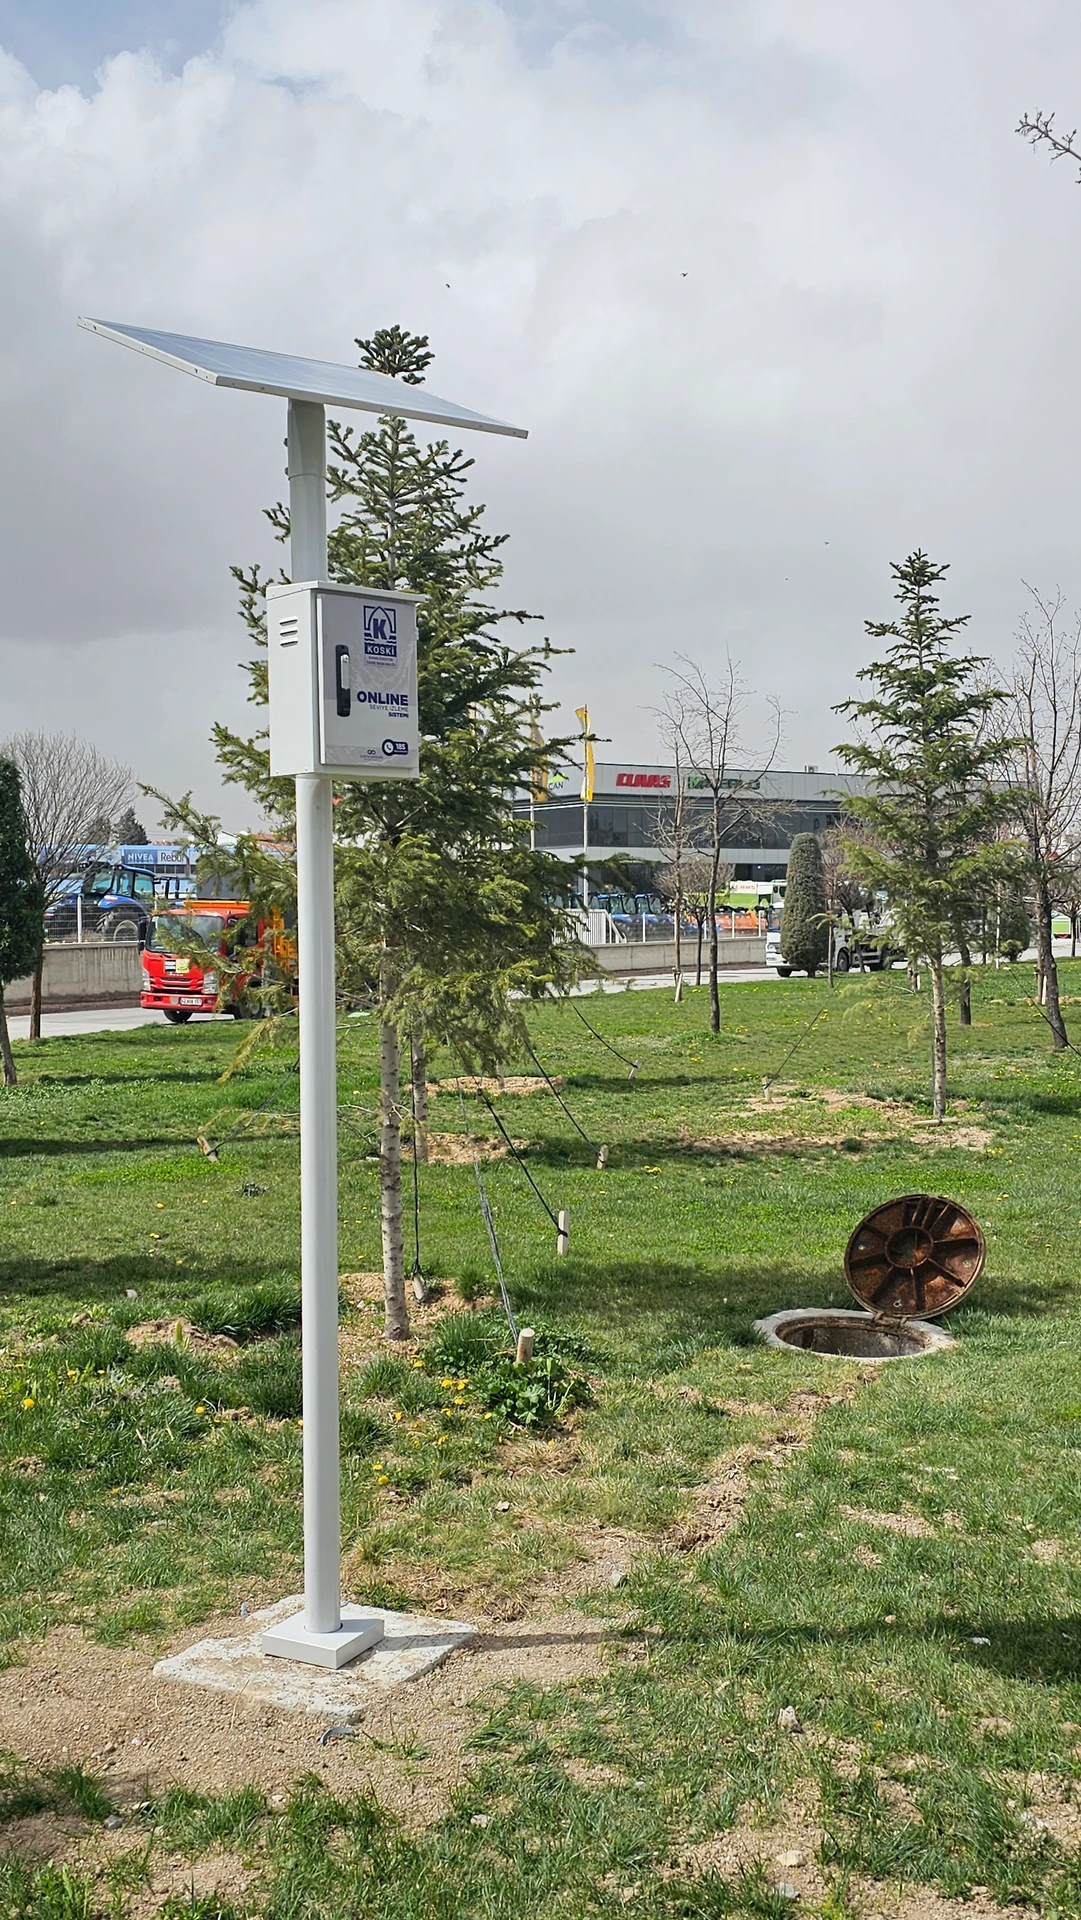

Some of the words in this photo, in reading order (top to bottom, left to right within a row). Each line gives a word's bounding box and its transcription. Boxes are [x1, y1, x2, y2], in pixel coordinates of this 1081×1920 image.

[373, 618, 387, 640] K
[367, 645, 395, 655] KOSKİ
[357, 691, 408, 706] ONLINE
[616, 773, 671, 788] CLAAS
